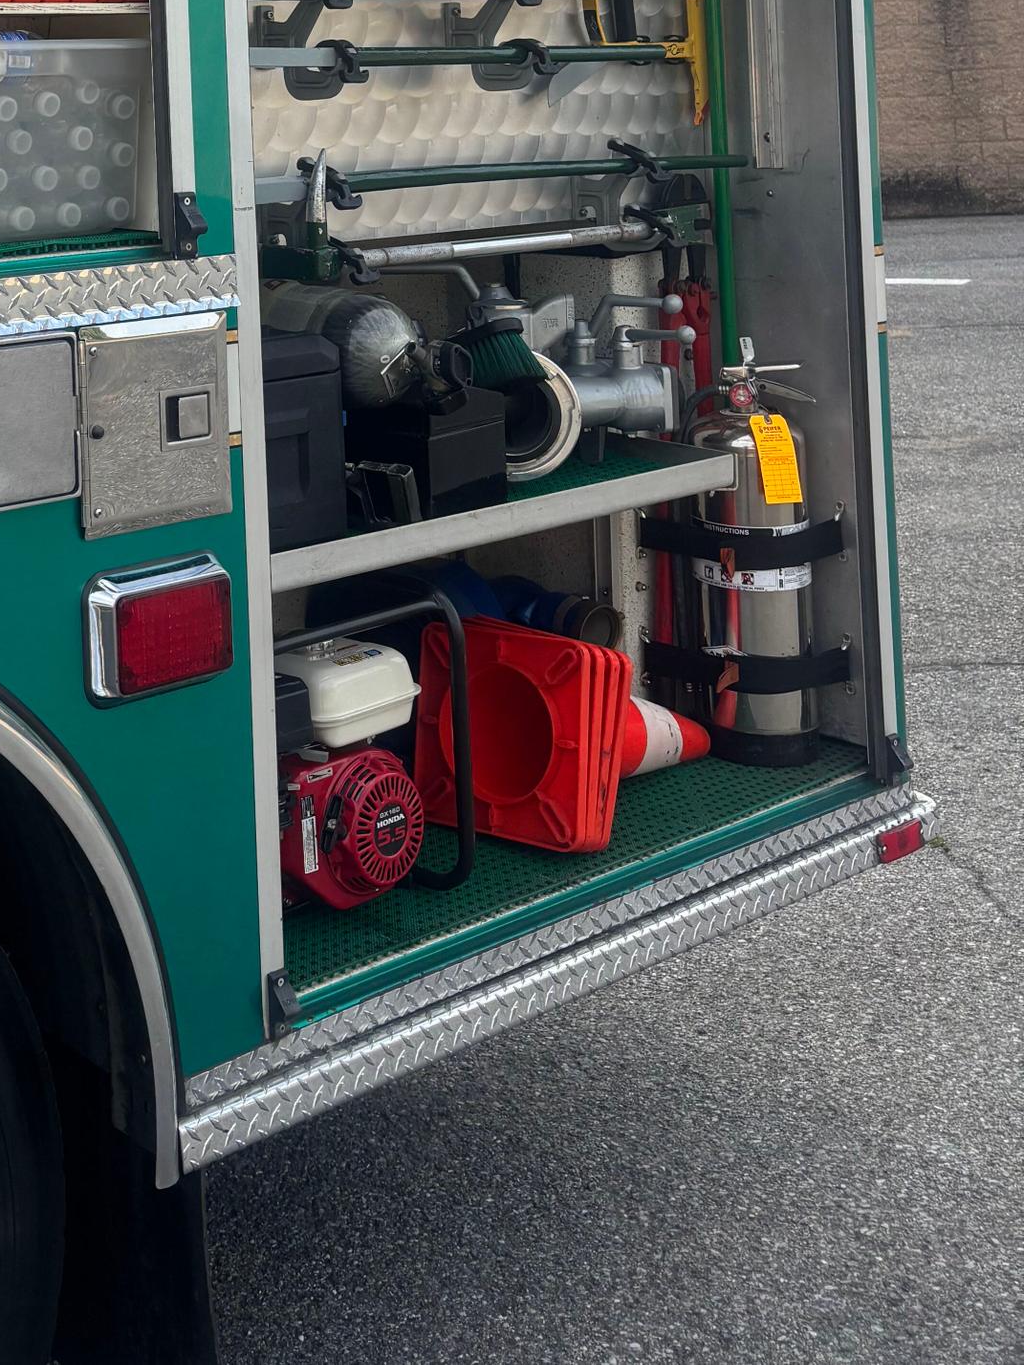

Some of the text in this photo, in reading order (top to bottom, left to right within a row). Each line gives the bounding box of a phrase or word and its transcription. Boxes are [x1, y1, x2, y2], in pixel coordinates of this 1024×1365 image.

[703, 522, 750, 536] INSTRUCTIONS
[376, 813, 406, 829] HONDA
[377, 824, 406, 848] 5.5
